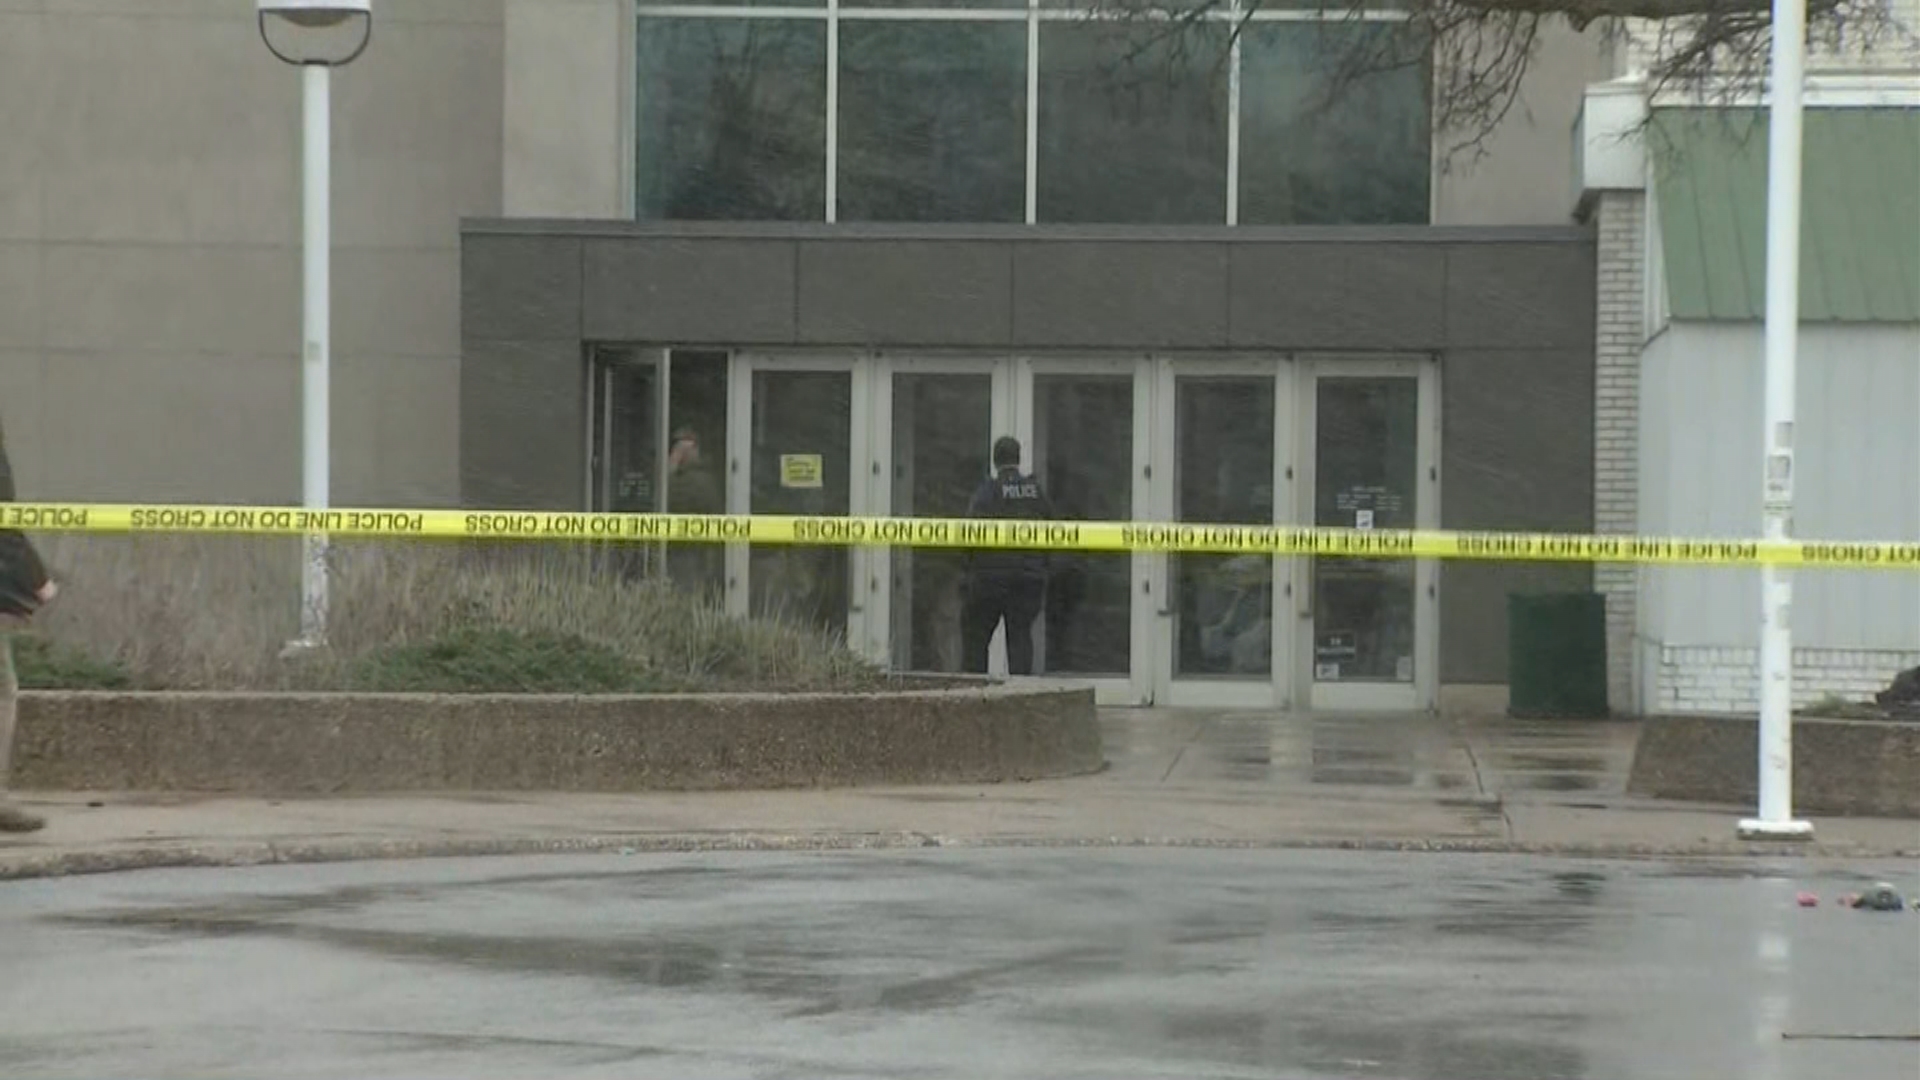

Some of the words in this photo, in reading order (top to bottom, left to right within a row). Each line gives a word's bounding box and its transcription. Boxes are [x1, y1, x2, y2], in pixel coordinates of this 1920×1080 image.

[1001, 483, 1039, 499] POLICE
[9, 507, 88, 527] POLICE
[130, 509, 206, 527] CROSS
[208, 509, 255, 529] NOT
[259, 510, 291, 528] DO
[295, 511, 342, 530] LINE
[347, 511, 424, 531] POLICE
[465, 514, 538, 533] CROSS
[541, 515, 585, 534] NOT
[590, 516, 621, 534] DO
[627, 516, 671, 536] LINE
[676, 517, 751, 537] POLICE
[793, 519, 865, 539] CROSS
[871, 520, 913, 540] NOT
[918, 521, 949, 541] DO
[954, 522, 999, 543] LINE
[1005, 523, 1080, 544] POLICE
[1885, 545, 1920, 563] OT
